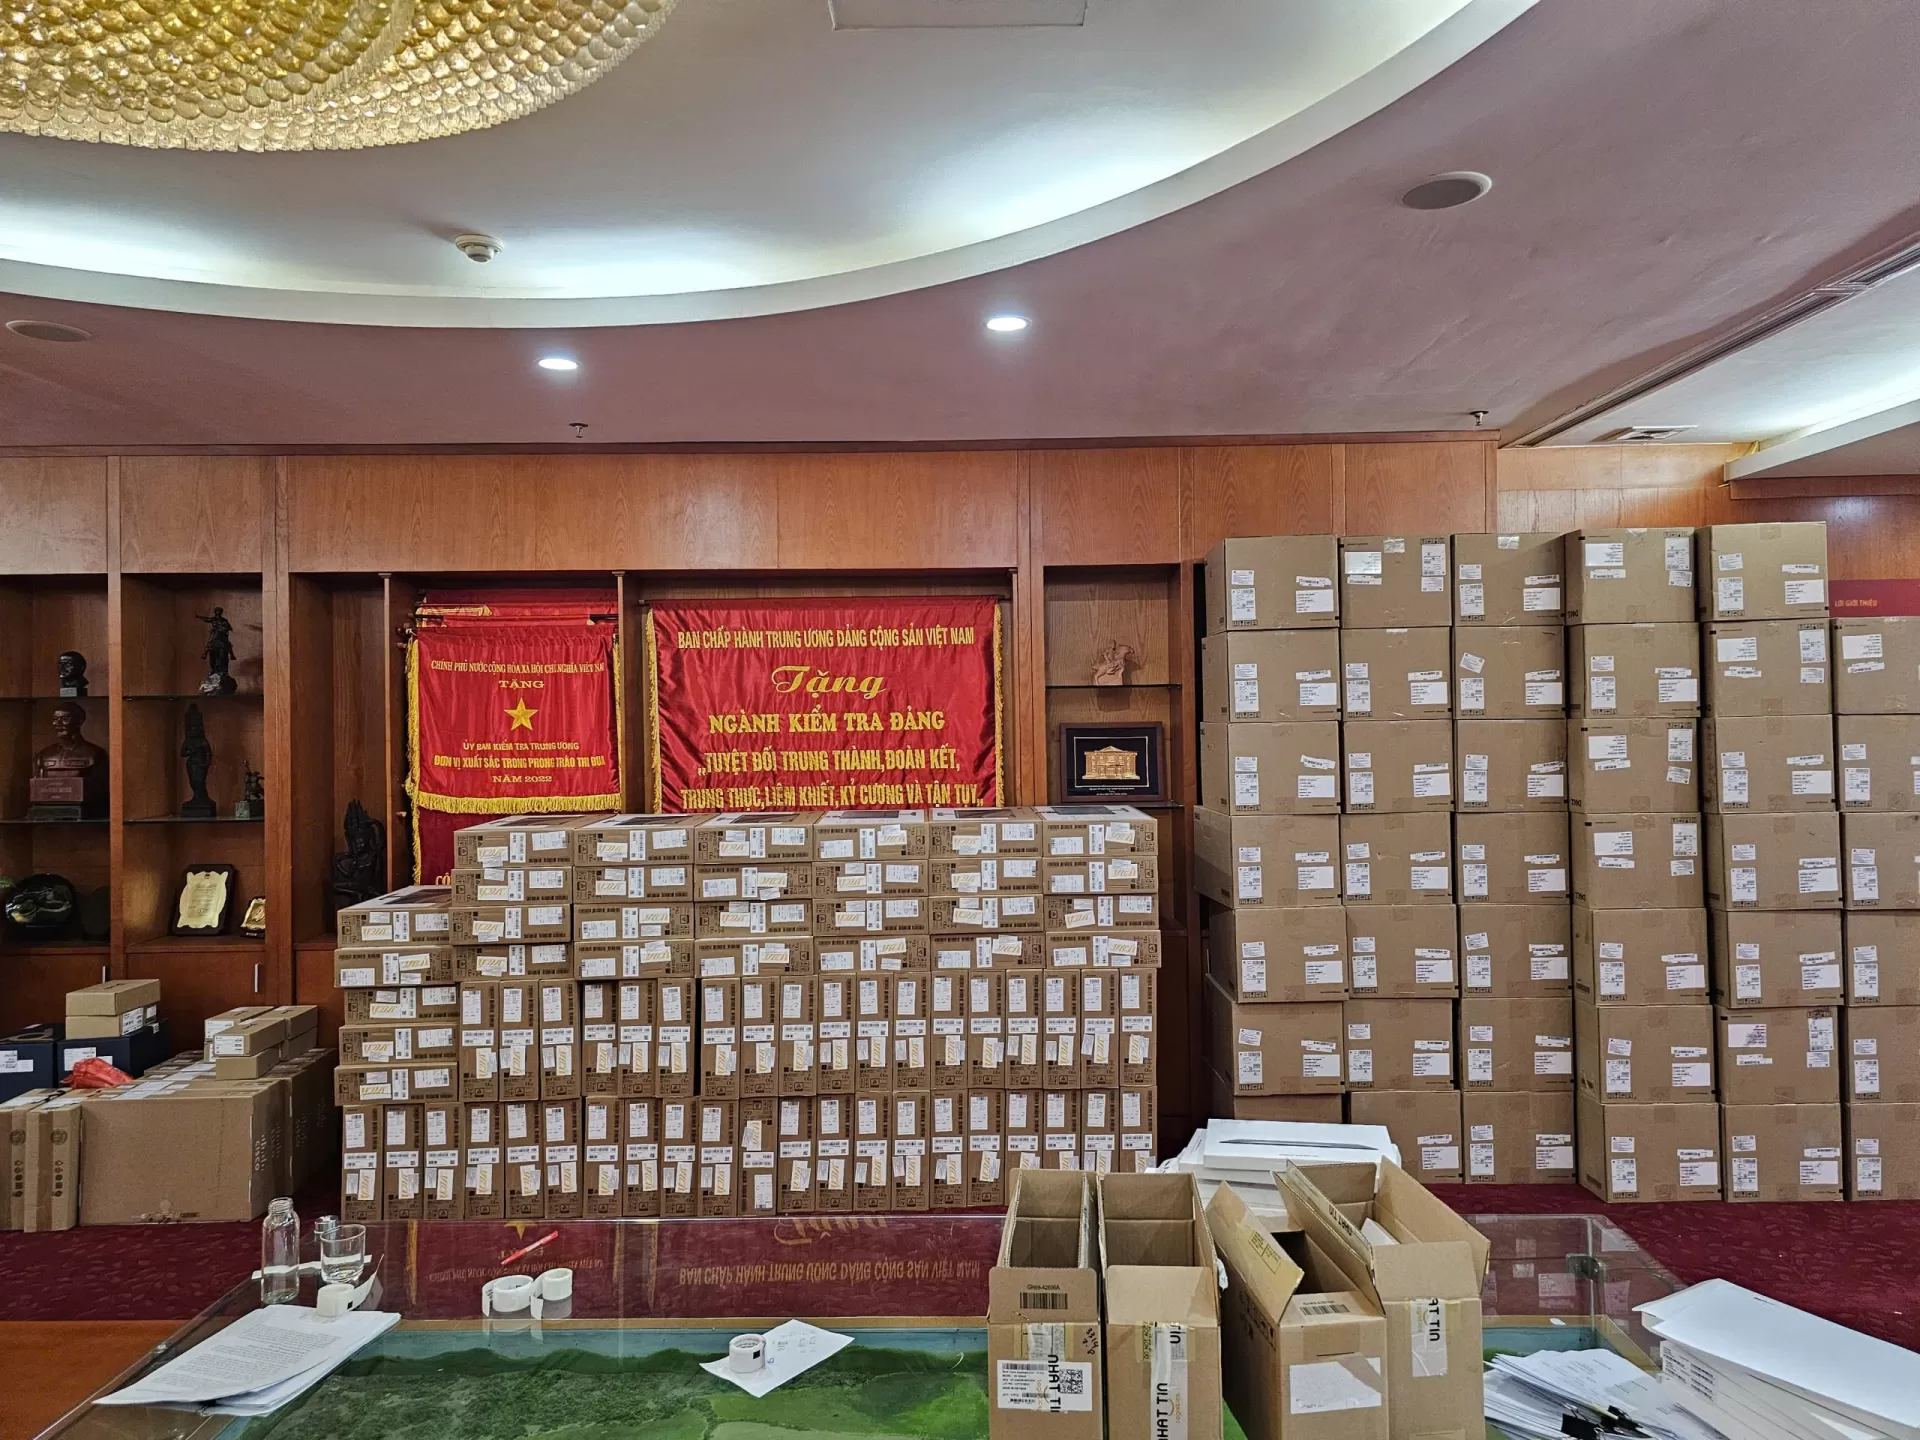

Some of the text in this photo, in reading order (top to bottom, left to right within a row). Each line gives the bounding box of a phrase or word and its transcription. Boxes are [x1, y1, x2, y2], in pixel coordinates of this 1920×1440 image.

[678, 622, 974, 651] BAN CHẤP HÀNH TRUNG ƯƠNG ĐẢNG CỘNG SẢN VIỆT NAM
[431, 659, 453, 671] CHÍNH
[454, 659, 468, 672] PHỦ
[469, 661, 487, 672] NƯỚC
[488, 661, 506, 676] CỘNG
[531, 662, 543, 676] HỘI
[557, 662, 578, 673] NGHĨA
[499, 678, 545, 690] TẶNG
[771, 665, 886, 700] Tặng
[709, 704, 945, 734] NGÀNH KIỂM TRA ĐẢNG
[463, 739, 474, 750] ỦY
[493, 739, 513, 750] KIỂM
[530, 742, 556, 750] TRUNG
[752, 745, 777, 772] ĐỐI
[780, 751, 829, 771] TRUNG
[930, 743, 960, 771] KẾT,
[434, 754, 606, 770] ĐƠN VỊ XUẤT SẮC TRONG PHONG TRÀO THI ĐUA
[492, 774, 522, 783] NĂM
[680, 788, 724, 809] TRUNG
[860, 783, 902, 805] CƯƠNG
[906, 780, 923, 804] VÀ
[926, 781, 950, 807] TẬN
[1157, 1409, 1168, 1440] HAT
